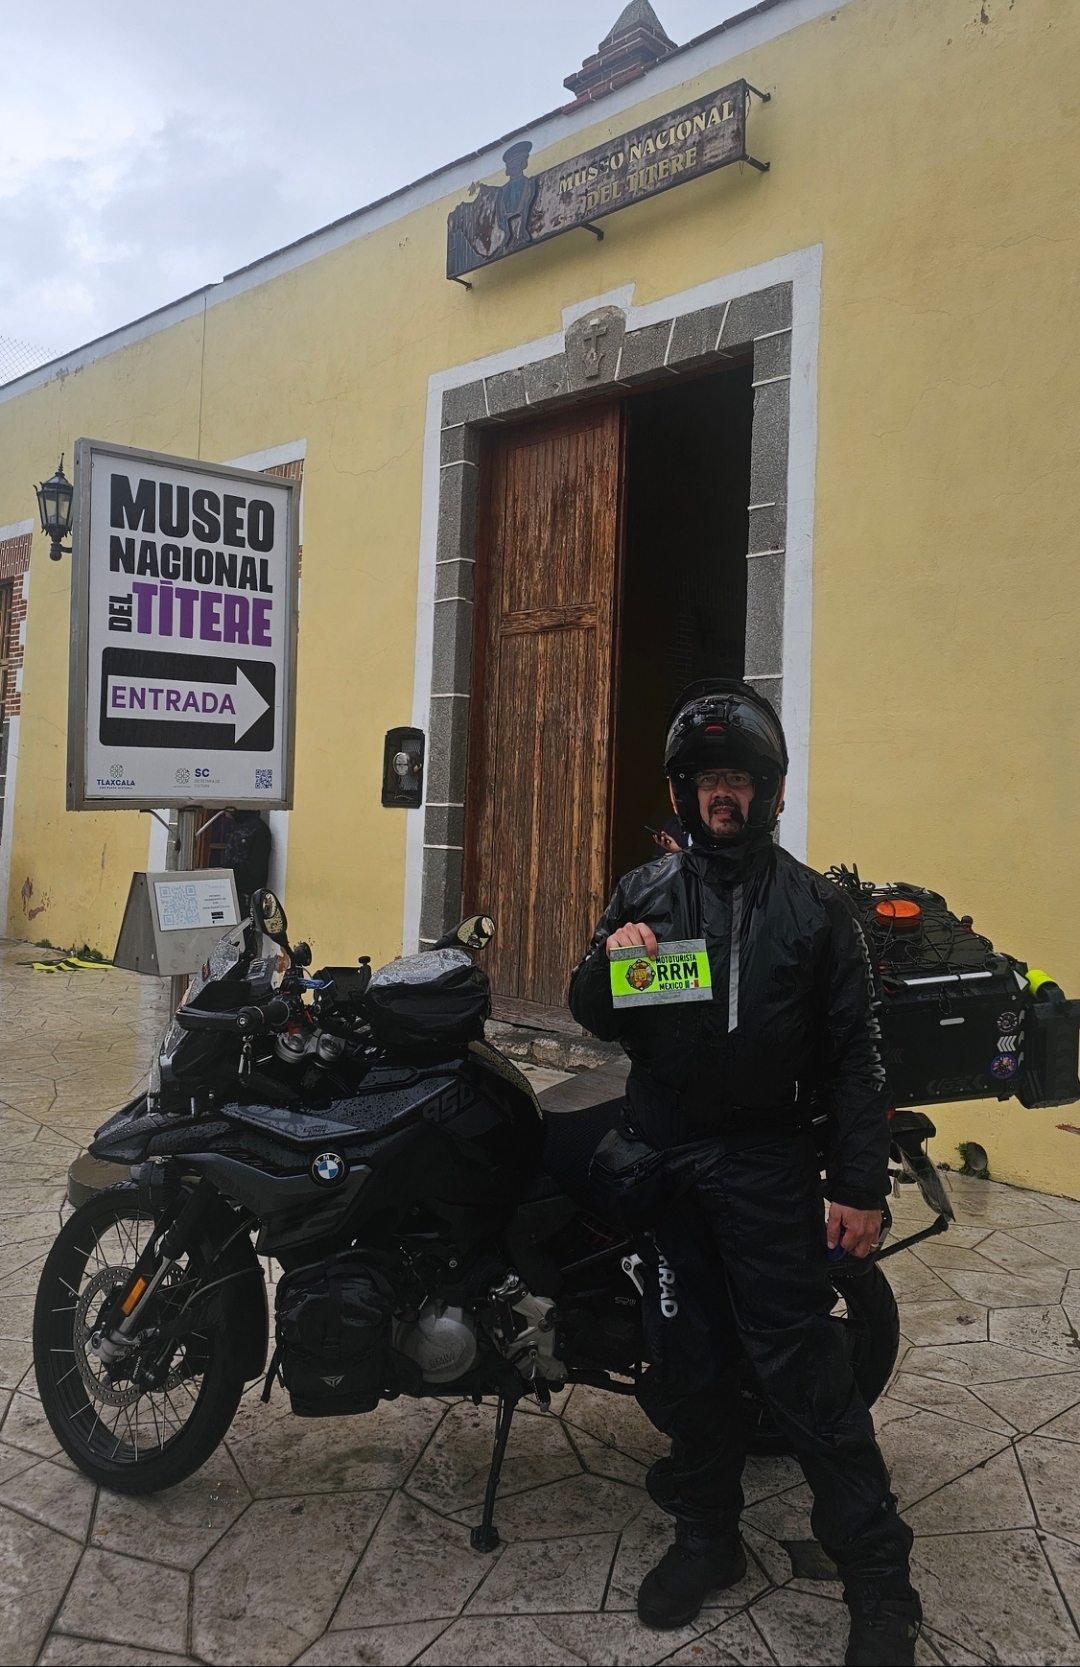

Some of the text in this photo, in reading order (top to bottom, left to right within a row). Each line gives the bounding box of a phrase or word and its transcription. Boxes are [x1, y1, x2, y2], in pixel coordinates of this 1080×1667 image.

[629, 101, 734, 163] NACIONAL
[586, 147, 697, 211] DEL TITERE
[110, 473, 275, 553] MUSEO
[109, 535, 273, 594] NACIONAL
[108, 593, 133, 633] DEL
[111, 685, 236, 715] ENTRADA
[194, 768, 210, 778] SC
[656, 953, 697, 964] MOTOTURISTA
[656, 961, 699, 982] RRM
[429, 1352, 456, 1368] BMW
